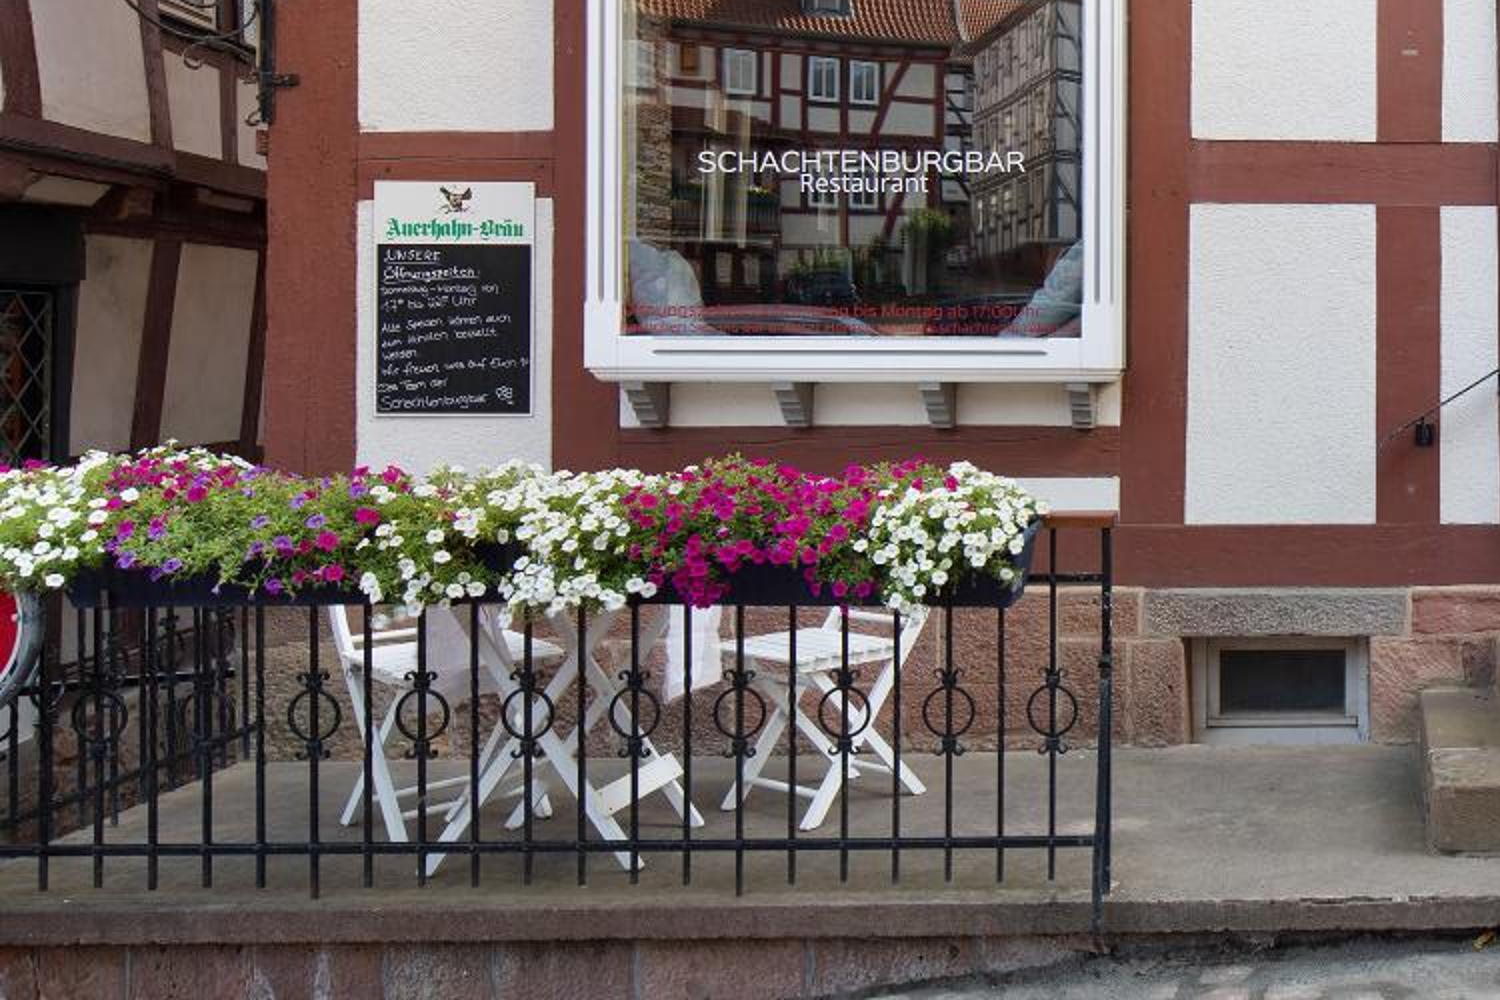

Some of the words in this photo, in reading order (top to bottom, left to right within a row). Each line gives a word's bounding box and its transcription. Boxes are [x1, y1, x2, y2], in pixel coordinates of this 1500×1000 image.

[697, 150, 1026, 173] SCHACHTENBURGBAR
[800, 173, 930, 193] Restaurant
[386, 217, 524, 241] Auerhahn-Bräu
